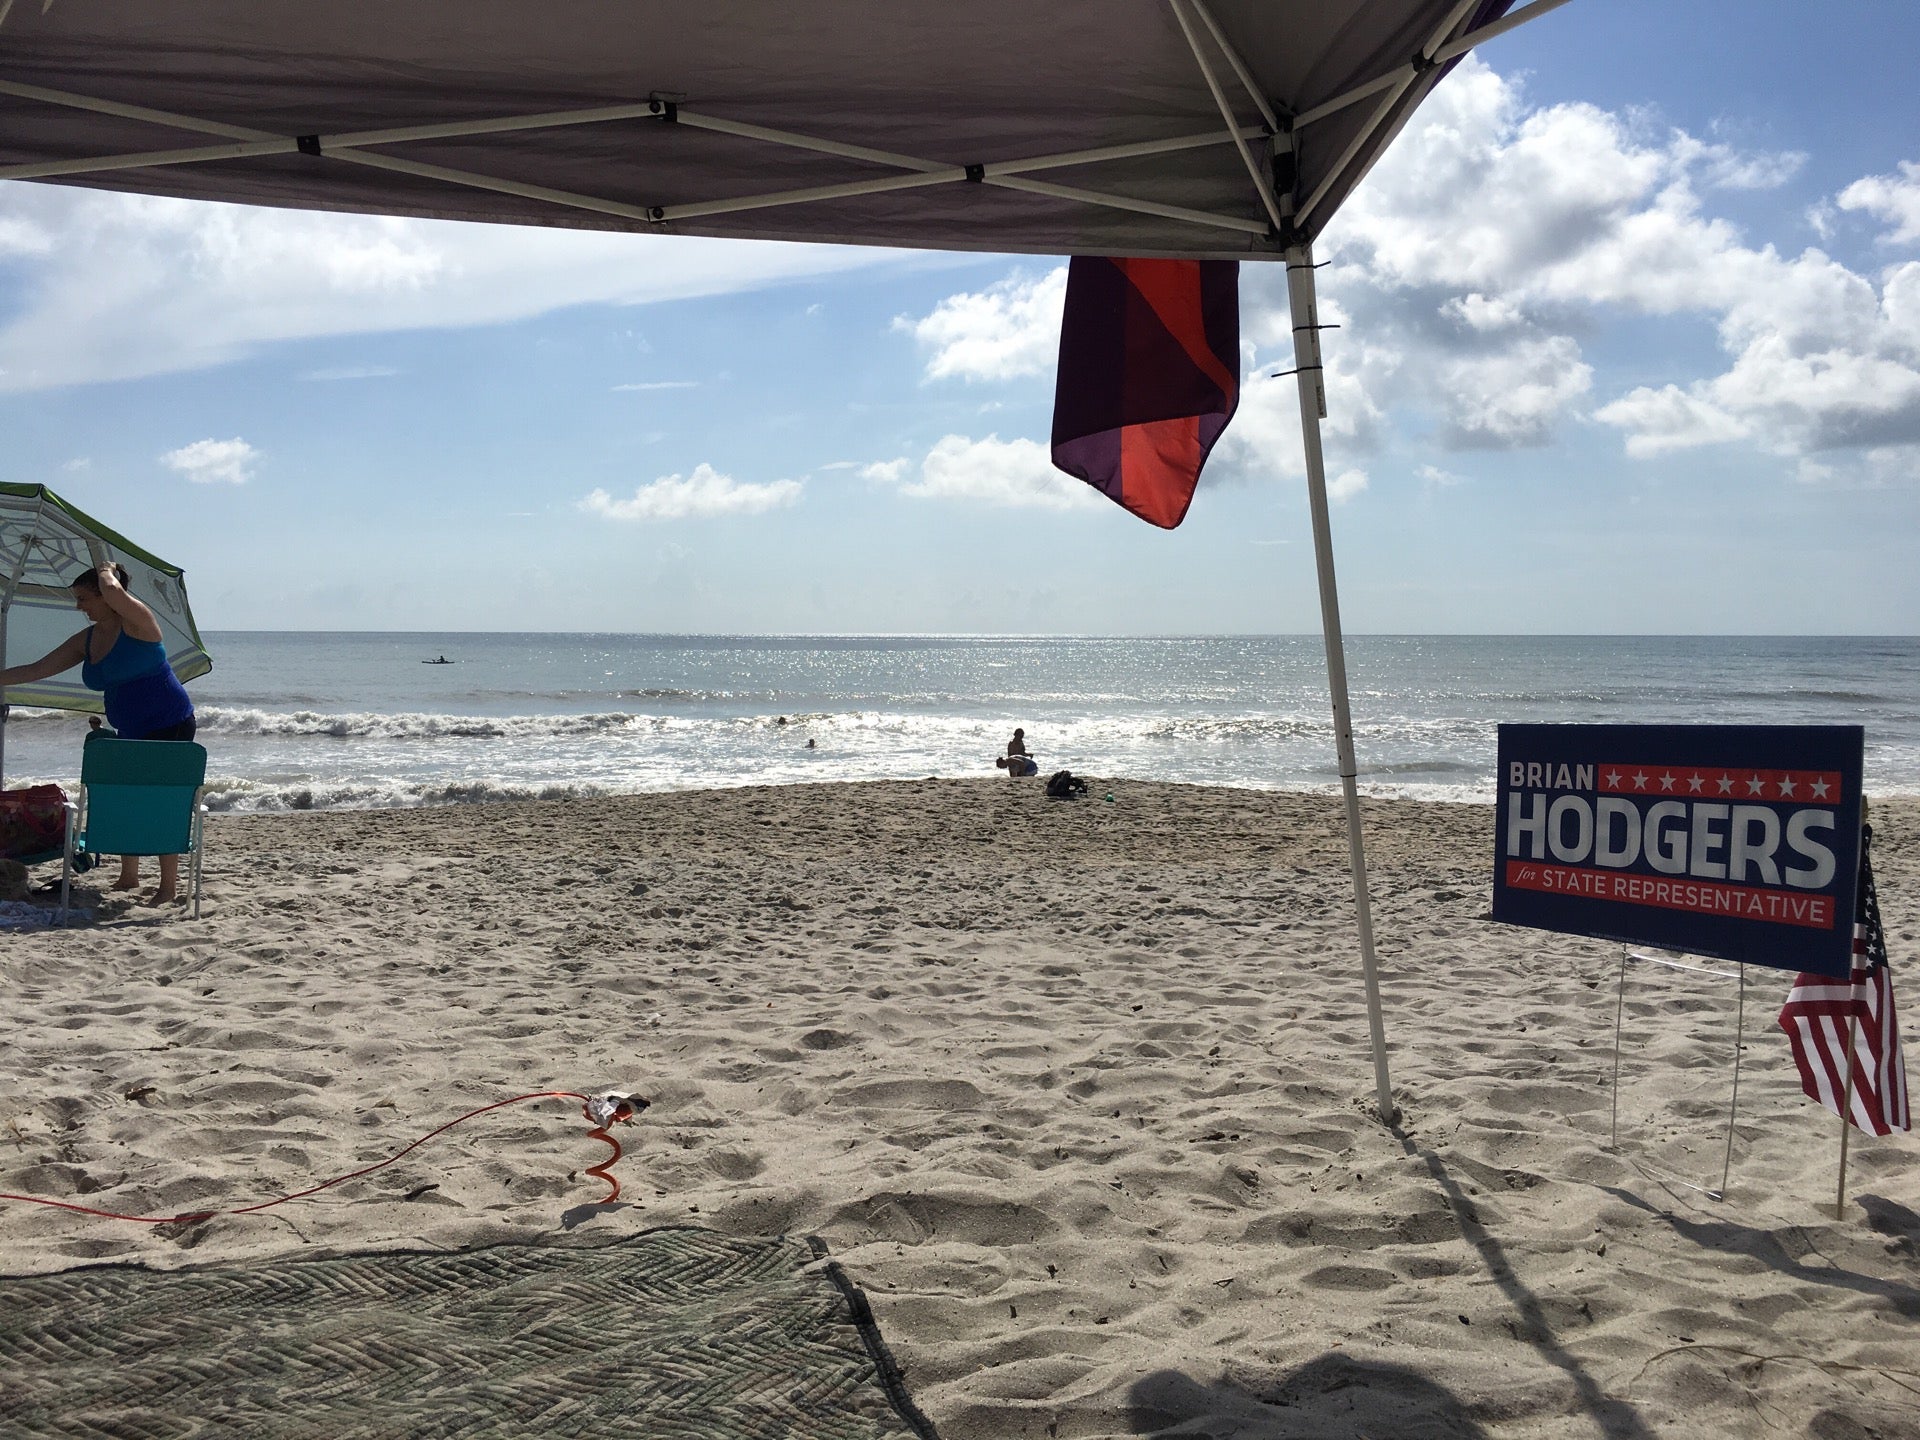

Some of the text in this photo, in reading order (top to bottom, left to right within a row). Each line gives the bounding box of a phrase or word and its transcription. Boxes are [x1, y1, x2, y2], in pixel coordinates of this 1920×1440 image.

[1510, 761, 1594, 791] BRIAN
[1506, 791, 1837, 889] HODGERS
[1513, 866, 1825, 923] for STATE REPRESENTATIVE
